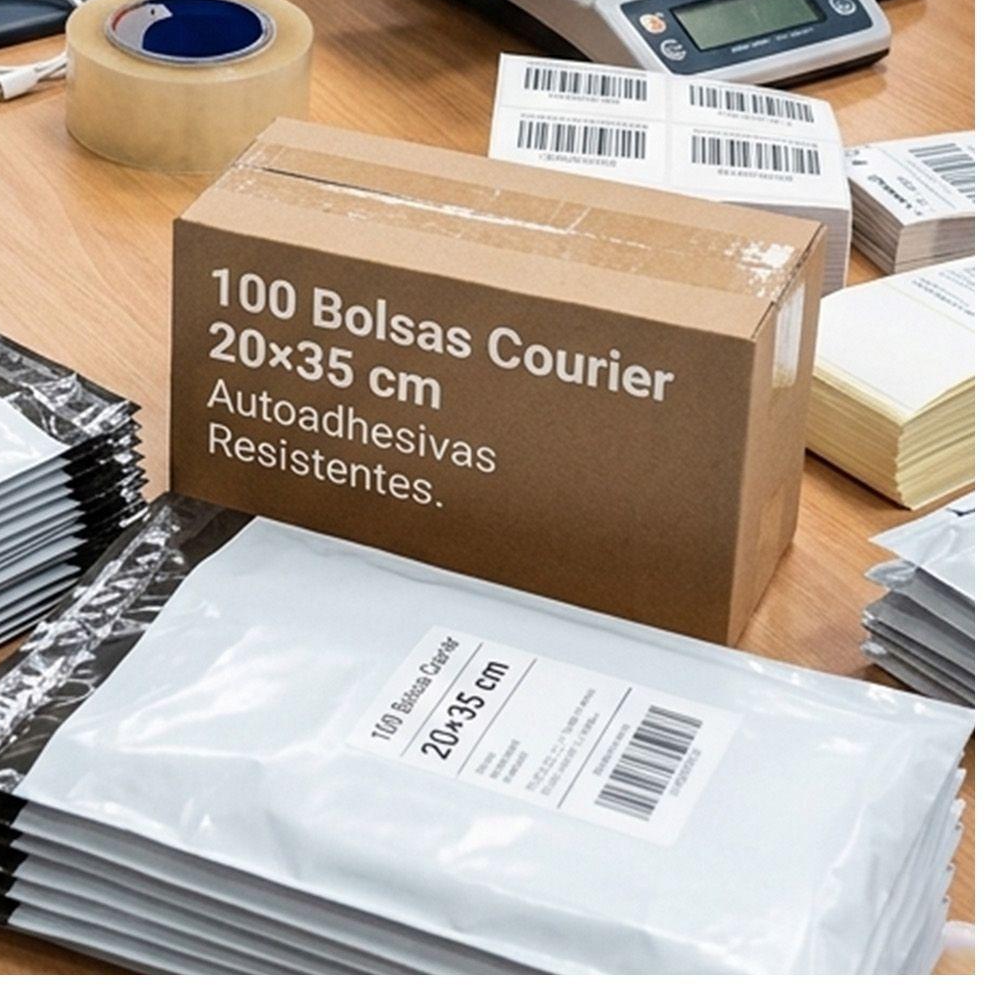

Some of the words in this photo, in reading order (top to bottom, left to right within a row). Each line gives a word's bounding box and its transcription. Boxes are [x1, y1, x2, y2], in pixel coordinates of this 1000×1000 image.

[209, 321, 354, 388] 20×35
[369, 366, 441, 410] cm
[211, 267, 297, 320] 100
[312, 286, 472, 359] Bolsas
[487, 326, 675, 402] Courier
[206, 378, 496, 473] Autoadhesivas
[209, 422, 443, 508] Resistentes.
[474, 661, 510, 691] cm
[371, 713, 403, 740] 100
